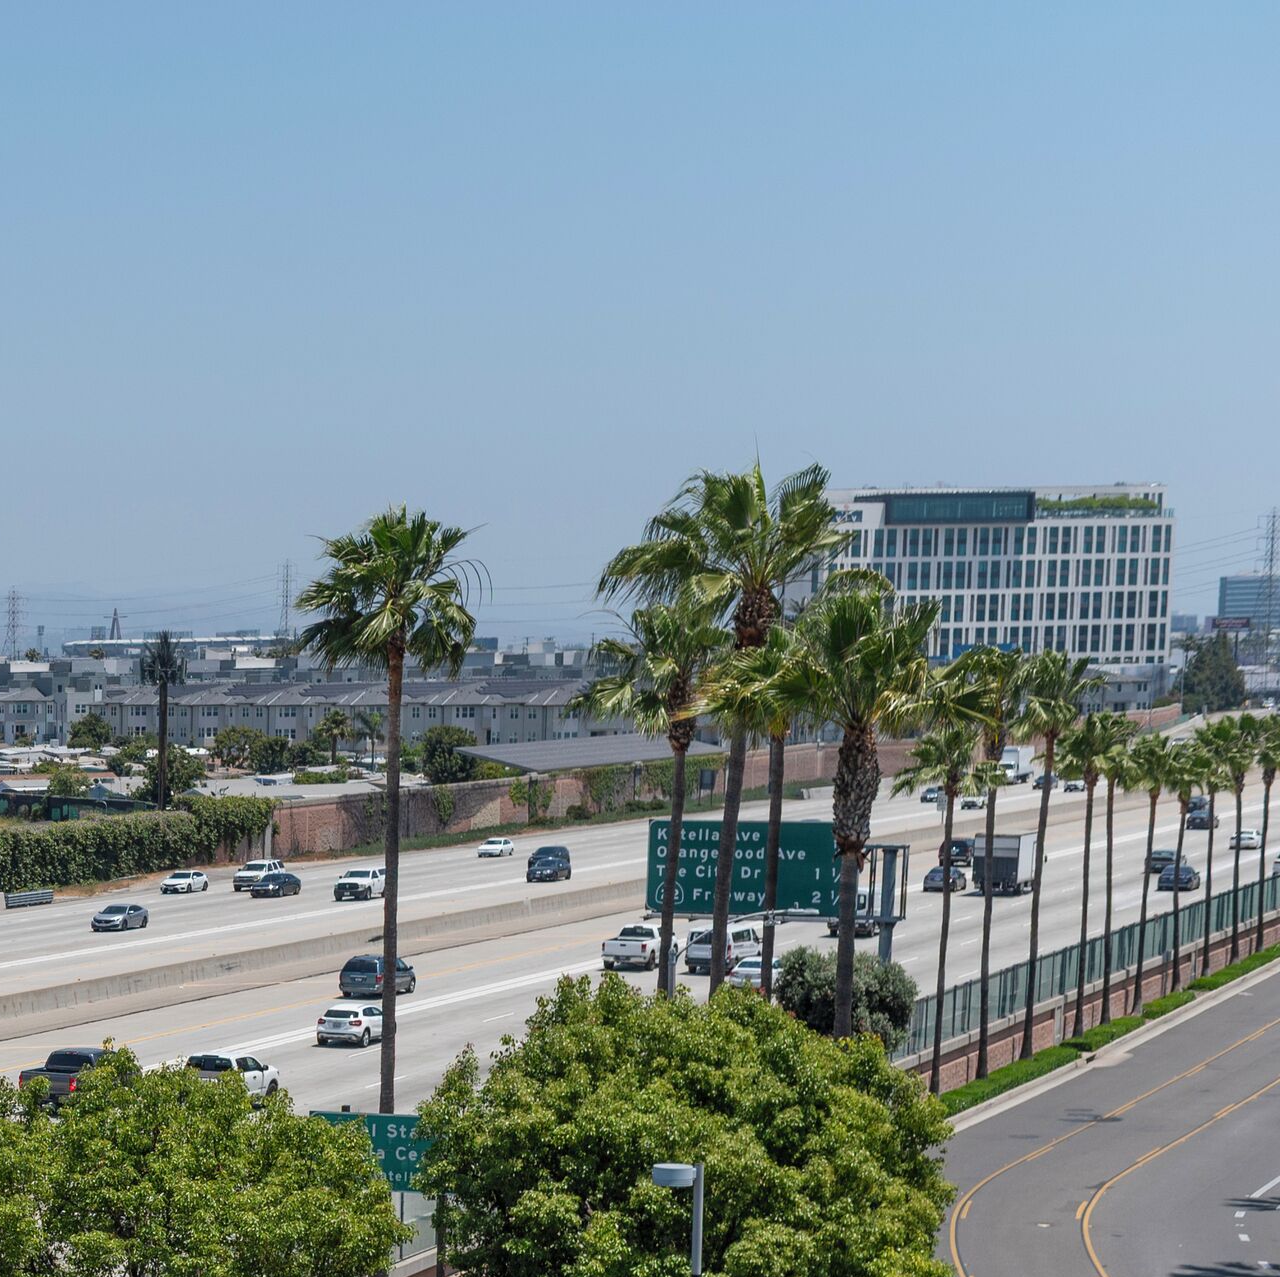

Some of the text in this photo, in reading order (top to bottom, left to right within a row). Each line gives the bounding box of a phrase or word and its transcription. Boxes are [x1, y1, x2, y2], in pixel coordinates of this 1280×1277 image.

[657, 828, 720, 841] Ktella
[657, 846, 765, 863] Oangeood
[656, 865, 687, 878] Te
[741, 866, 761, 879] Dr
[693, 888, 766, 907] Frway
[811, 891, 821, 903] 2
